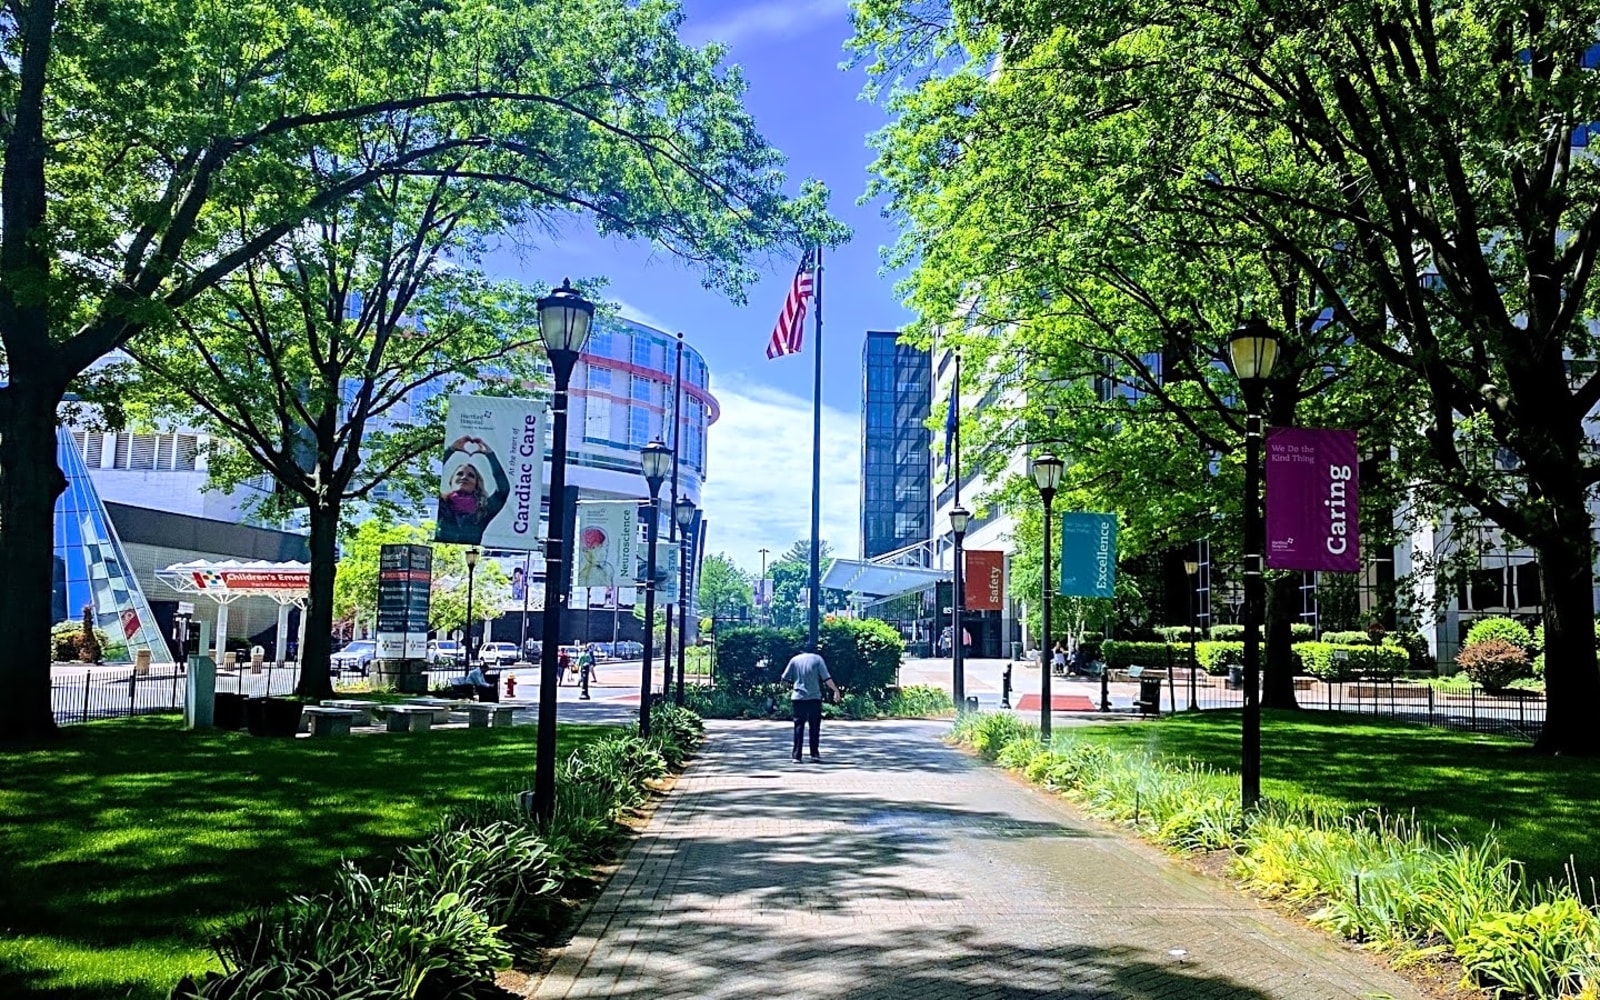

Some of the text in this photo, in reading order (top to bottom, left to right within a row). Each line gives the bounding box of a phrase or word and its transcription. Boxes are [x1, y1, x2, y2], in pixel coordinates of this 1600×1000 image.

[508, 427, 520, 477] At the heart of
[1271, 444, 1315, 454] We Do the
[1271, 454, 1315, 464] Kind Thing
[513, 414, 537, 535] Cardiac Care
[1324, 464, 1352, 555] Caring
[620, 509, 631, 578] Neuroscience
[667, 548, 676, 572] STAR
[1096, 522, 1110, 589] Excellence
[226, 573, 276, 581] Children's
[989, 566, 1002, 603] Safety
